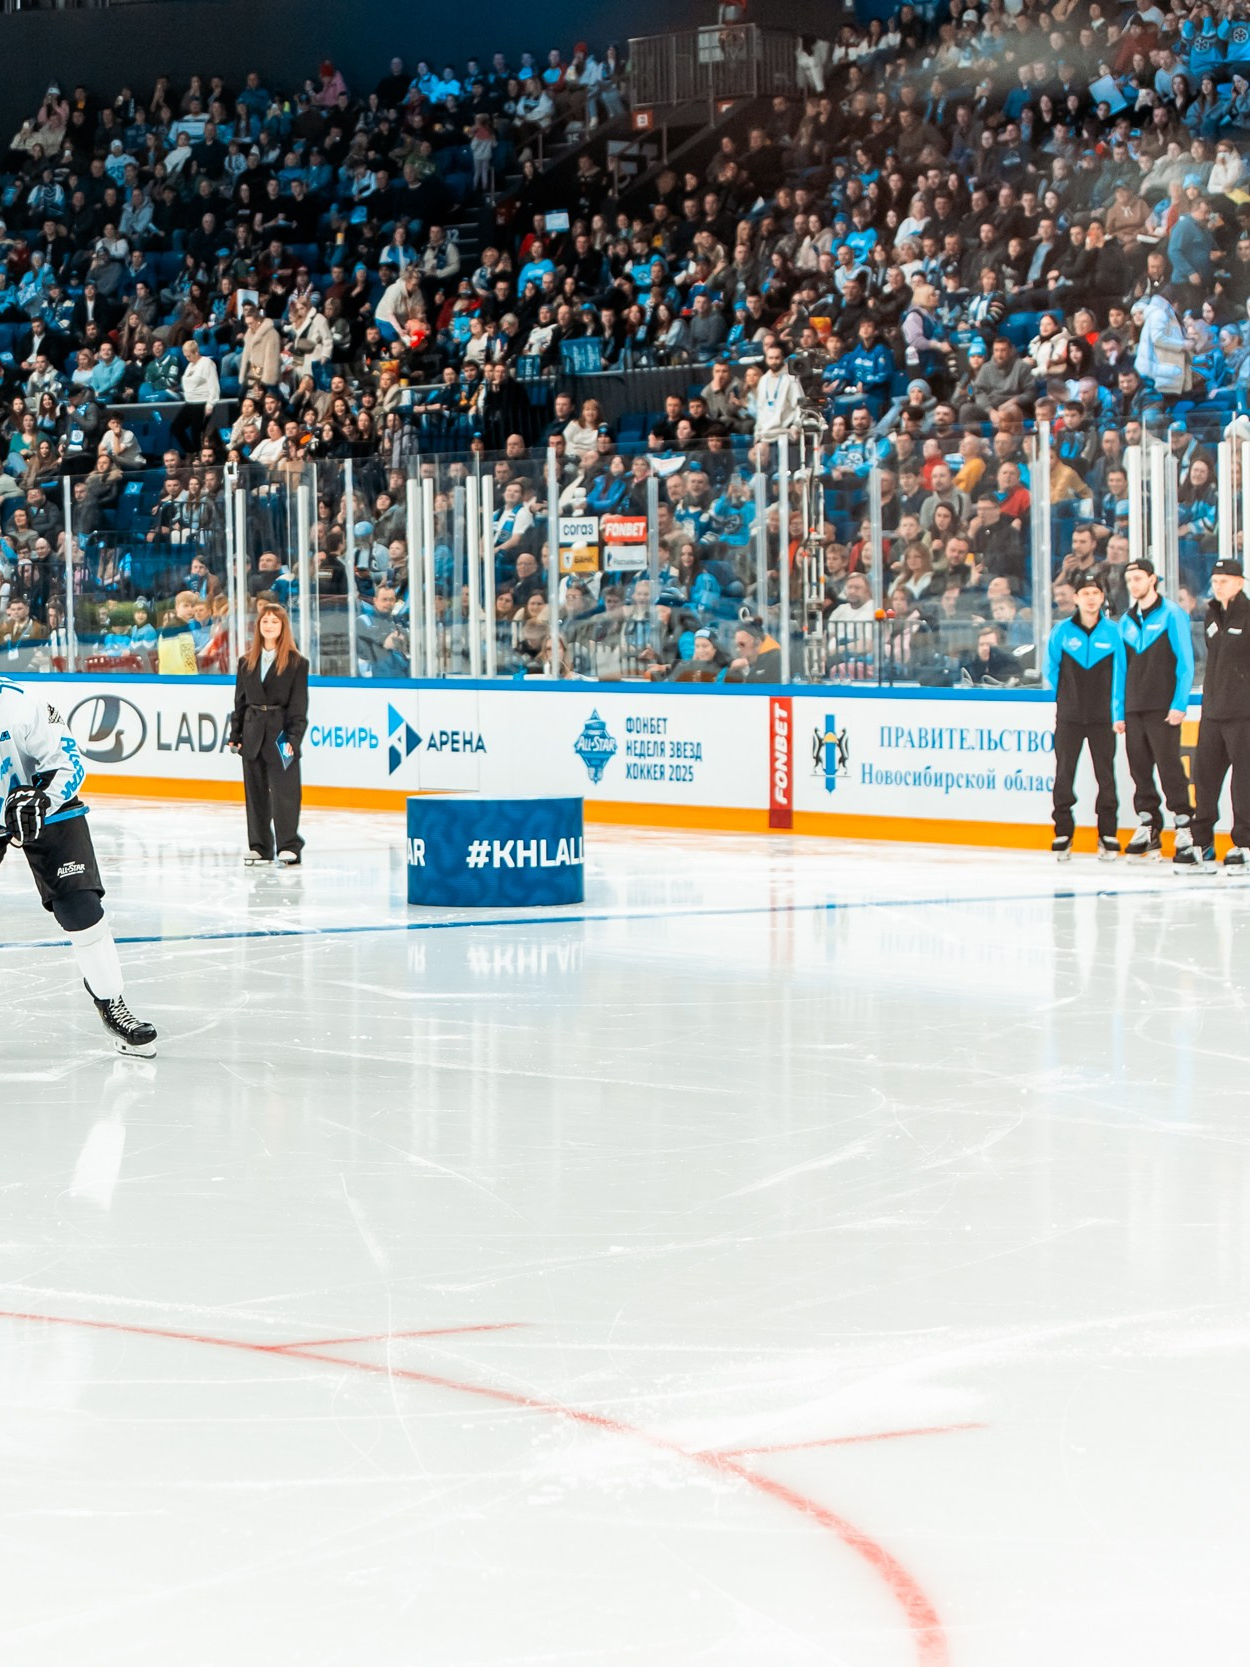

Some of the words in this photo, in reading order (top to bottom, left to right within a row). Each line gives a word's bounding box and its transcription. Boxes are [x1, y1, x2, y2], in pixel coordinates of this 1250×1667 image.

[605, 522, 646, 537] FONBET
[625, 716, 668, 735] ФОНБЕТ
[310, 725, 379, 750] СИБИРЬ
[426, 730, 487, 754] АРЕНА
[625, 740, 666, 761] НЕДЕЛЯ
[669, 741, 703, 762] ЗВЕЗД
[878, 725, 1055, 753] ПРАВИТЕЛЬСТВО
[774, 702, 789, 806] FONBET
[625, 763, 666, 781] ХОККЕЯ
[668, 764, 695, 783] 2025
[860, 762, 997, 795] Новосибирской
[1003, 769, 1054, 793] облас
